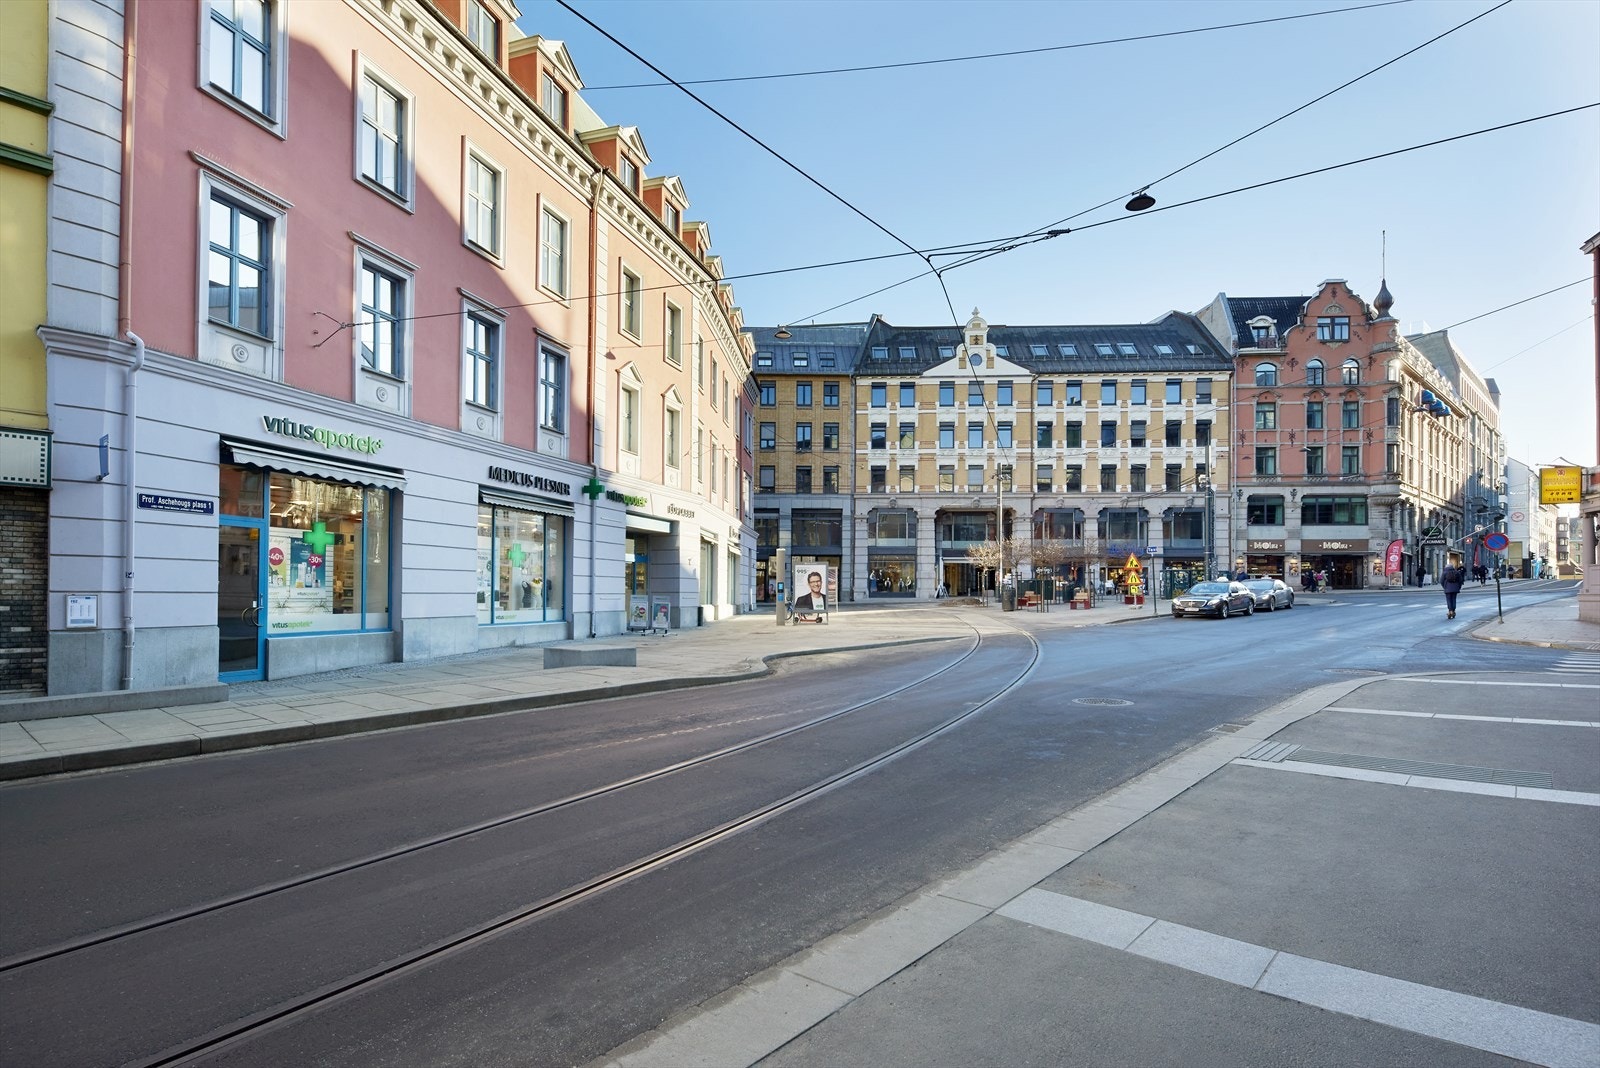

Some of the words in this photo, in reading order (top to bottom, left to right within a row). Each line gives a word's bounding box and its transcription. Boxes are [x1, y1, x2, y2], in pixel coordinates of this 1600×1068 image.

[488, 465, 534, 488] MEDICUS
[534, 476, 571, 496] PLESNER
[141, 495, 156, 503] Prof.
[158, 497, 191, 508] Aschehougs
[192, 501, 207, 509] plass
